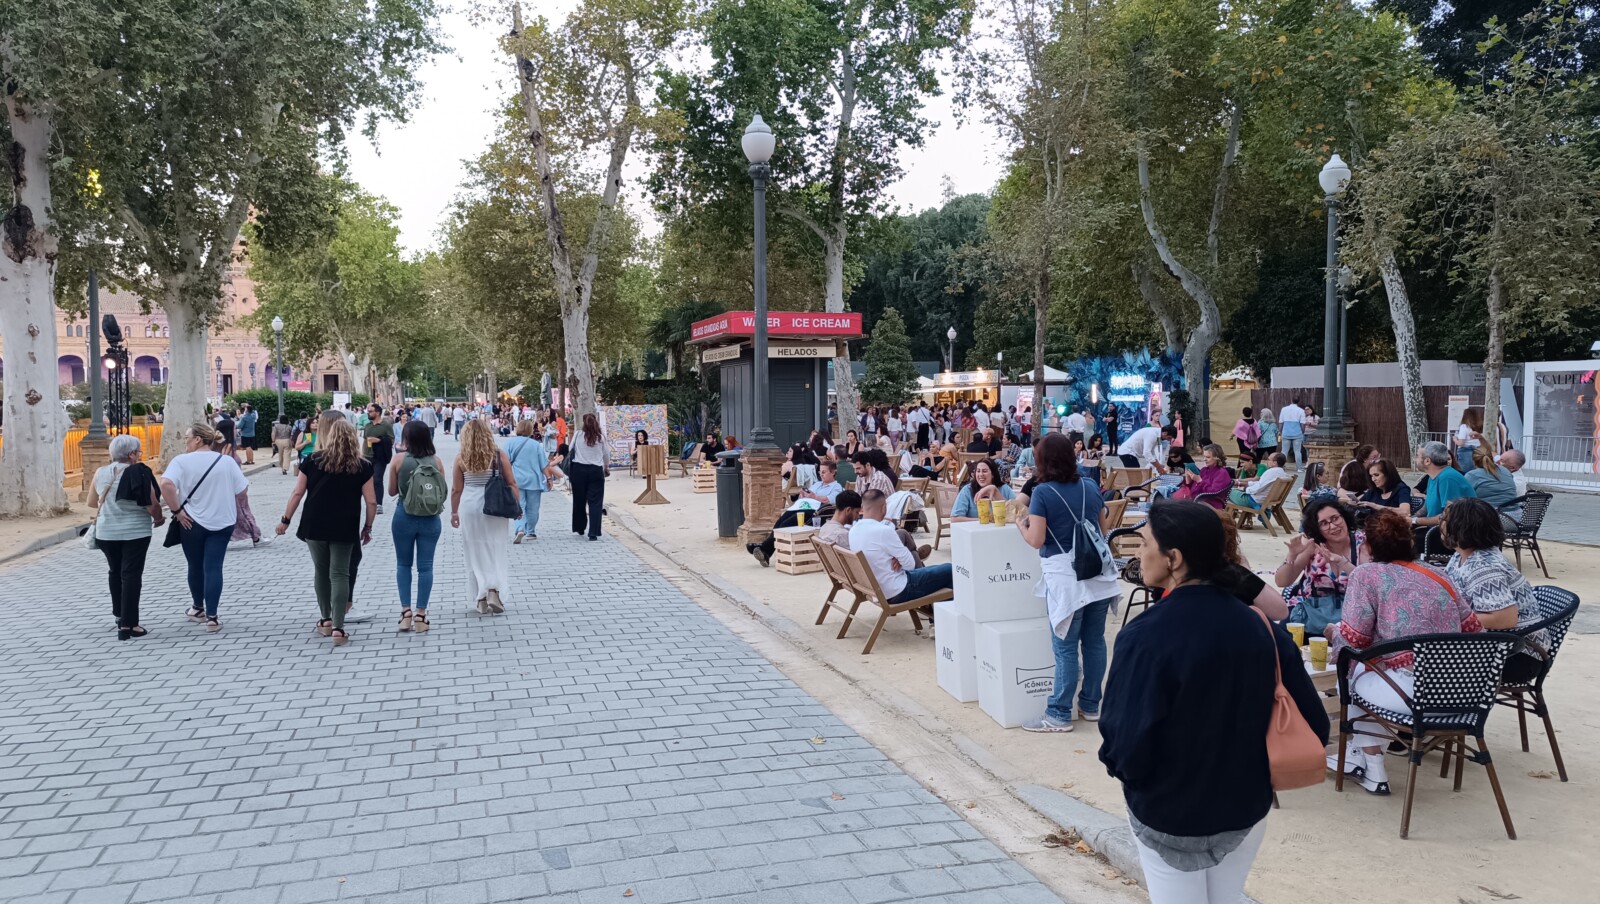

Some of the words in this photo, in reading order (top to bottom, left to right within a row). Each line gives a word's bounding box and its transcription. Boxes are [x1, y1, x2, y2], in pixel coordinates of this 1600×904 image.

[743, 317, 780, 327] WER
[792, 318, 809, 328] ICE
[812, 318, 851, 328] CREAM
[777, 348, 818, 356] HELADOS
[988, 571, 1031, 584] SCALPERS
[942, 646, 954, 662] ABC
